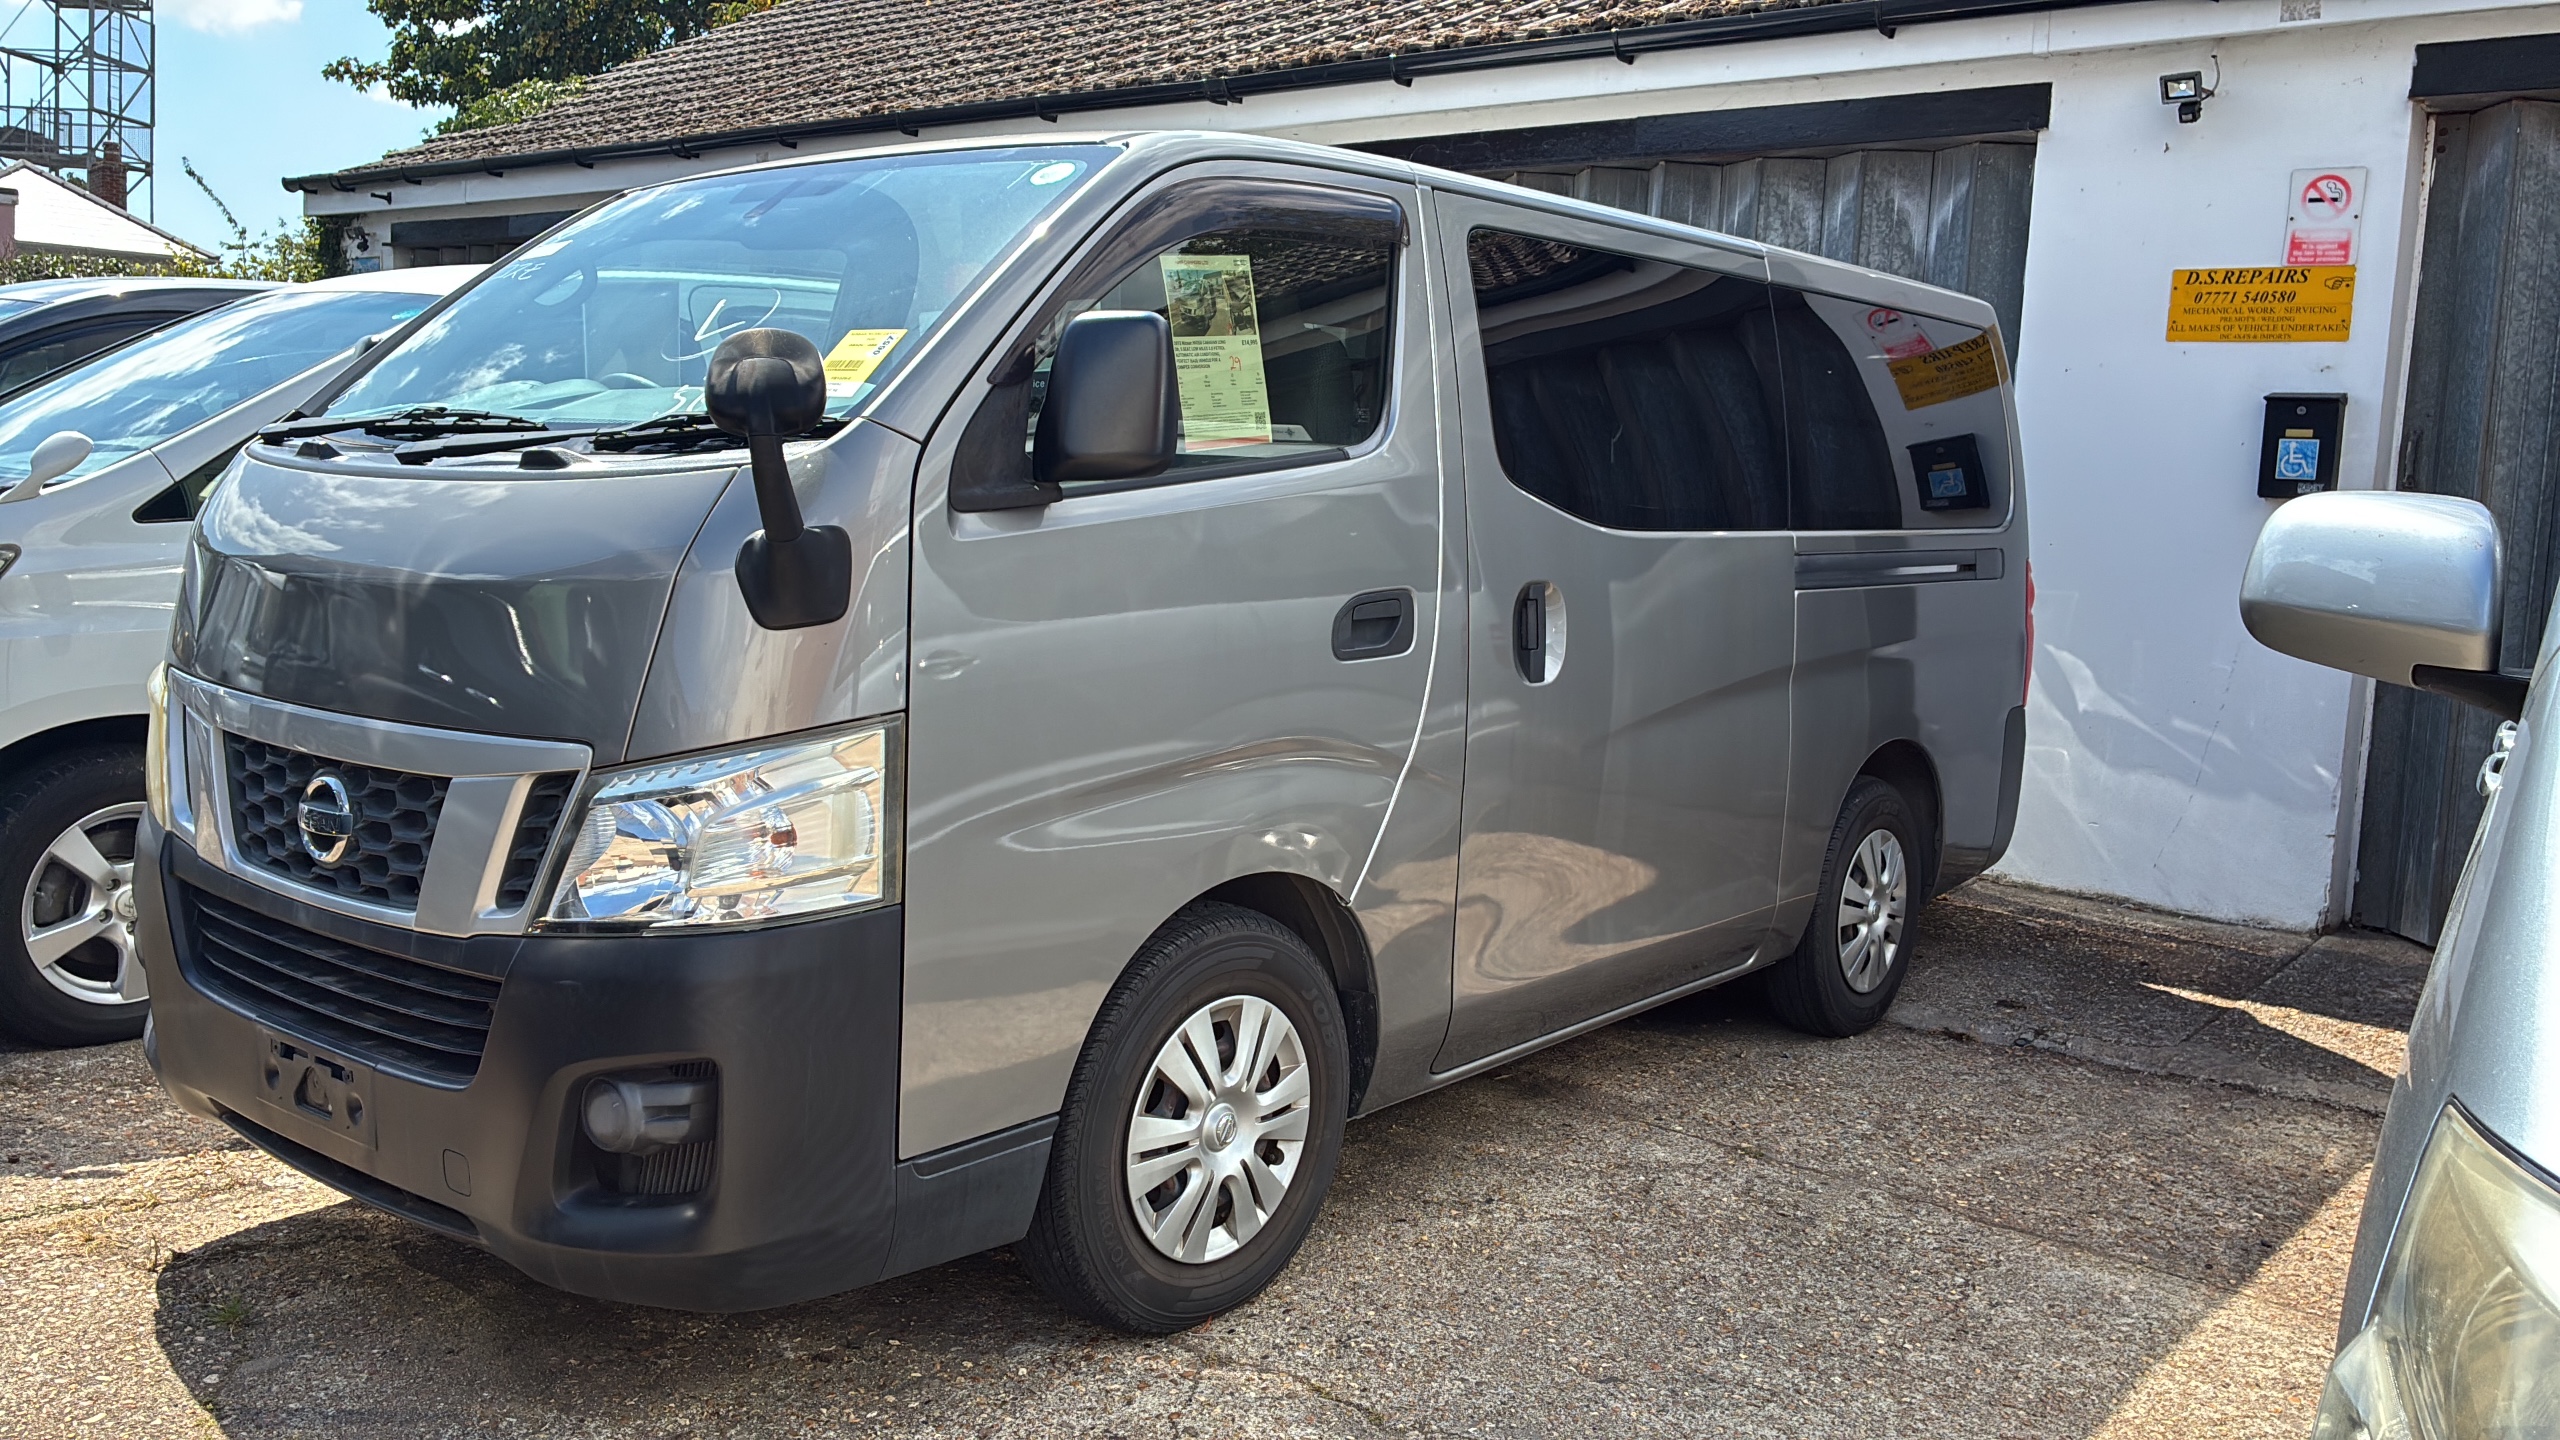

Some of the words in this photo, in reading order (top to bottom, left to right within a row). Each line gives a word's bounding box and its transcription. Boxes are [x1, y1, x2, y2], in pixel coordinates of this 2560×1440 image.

[2185, 268, 2311, 285] D.S.REPAIRS
[2193, 291, 2238, 304] 07771
[2241, 290, 2297, 304] 540580
[2183, 307, 2245, 315] MECHANICAL
[2247, 306, 2276, 314] WORK
[2284, 306, 2337, 314] SERVICING
[2169, 324, 2186, 332] ALL
[2188, 324, 2221, 332] MAKES
[2222, 324, 2235, 332] OF
[2237, 324, 2278, 332] VEHICLE
[2280, 323, 2349, 332] UNDERTAKEN
